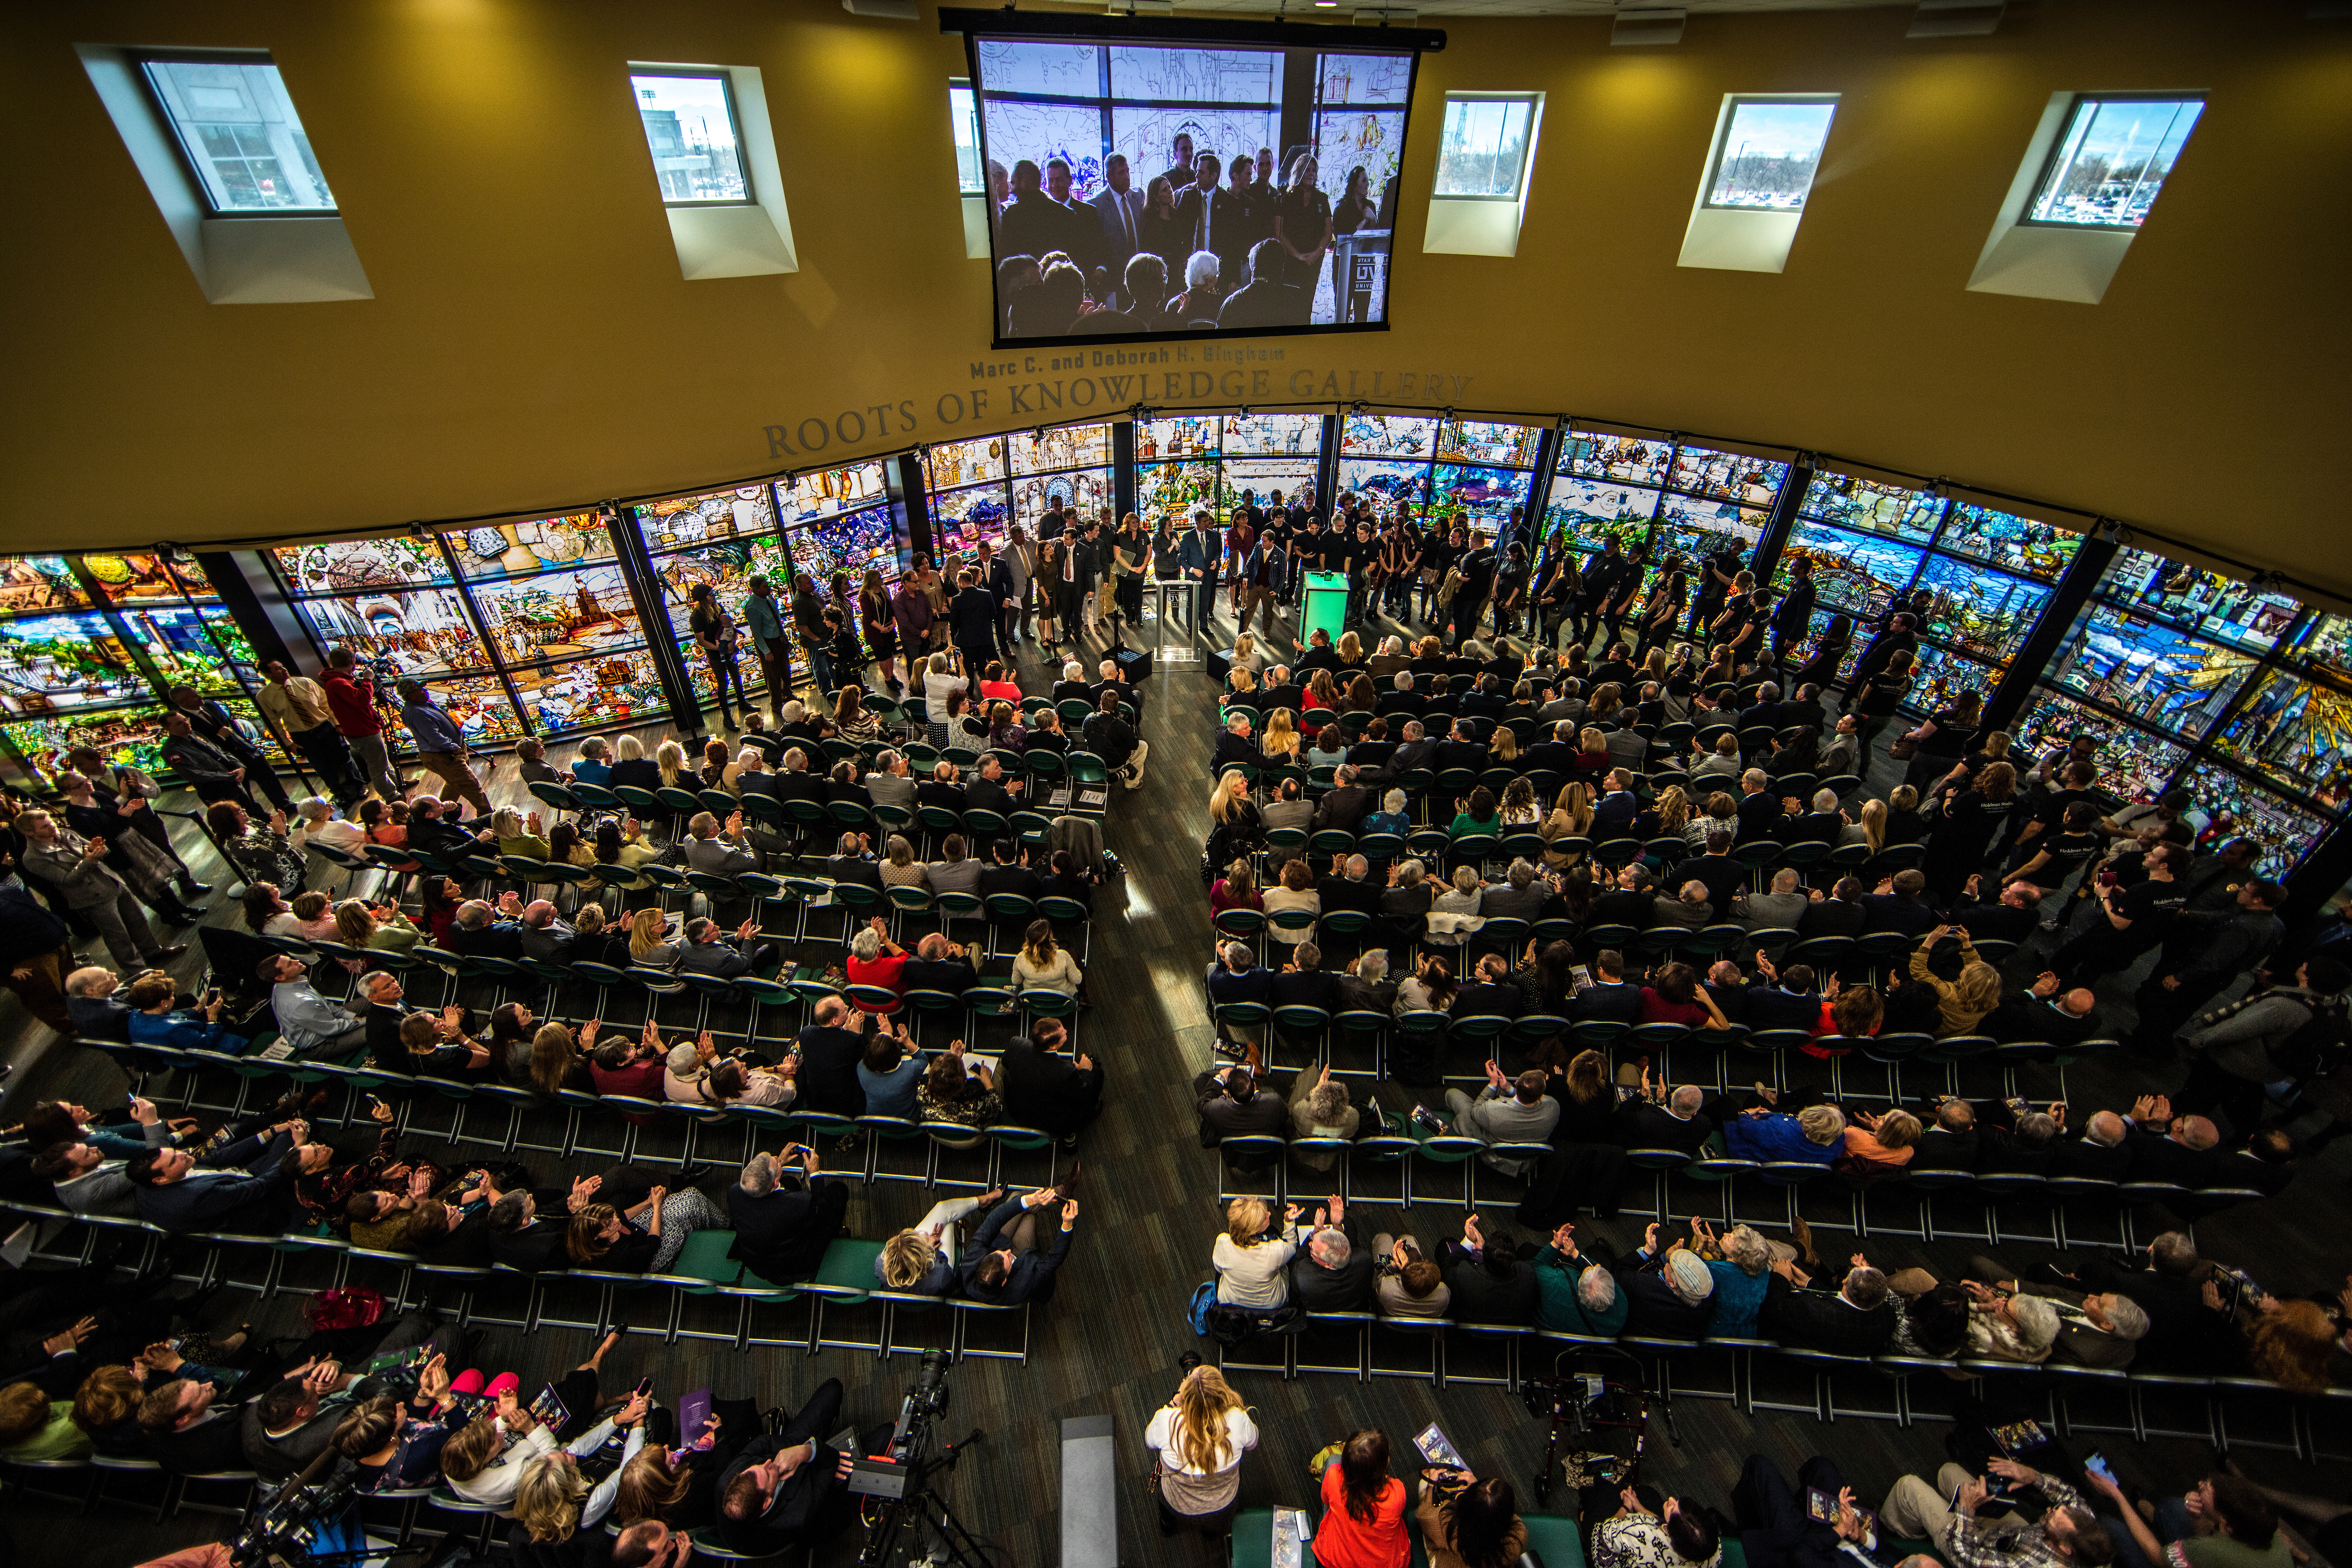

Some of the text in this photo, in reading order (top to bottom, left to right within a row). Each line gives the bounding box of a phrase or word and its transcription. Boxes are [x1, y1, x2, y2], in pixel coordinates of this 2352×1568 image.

[971, 344, 1285, 379] Marc C. and Deborah H. Bingham
[762, 369, 1474, 459] ROOTS OF KNOWLEDGE GALLERY
